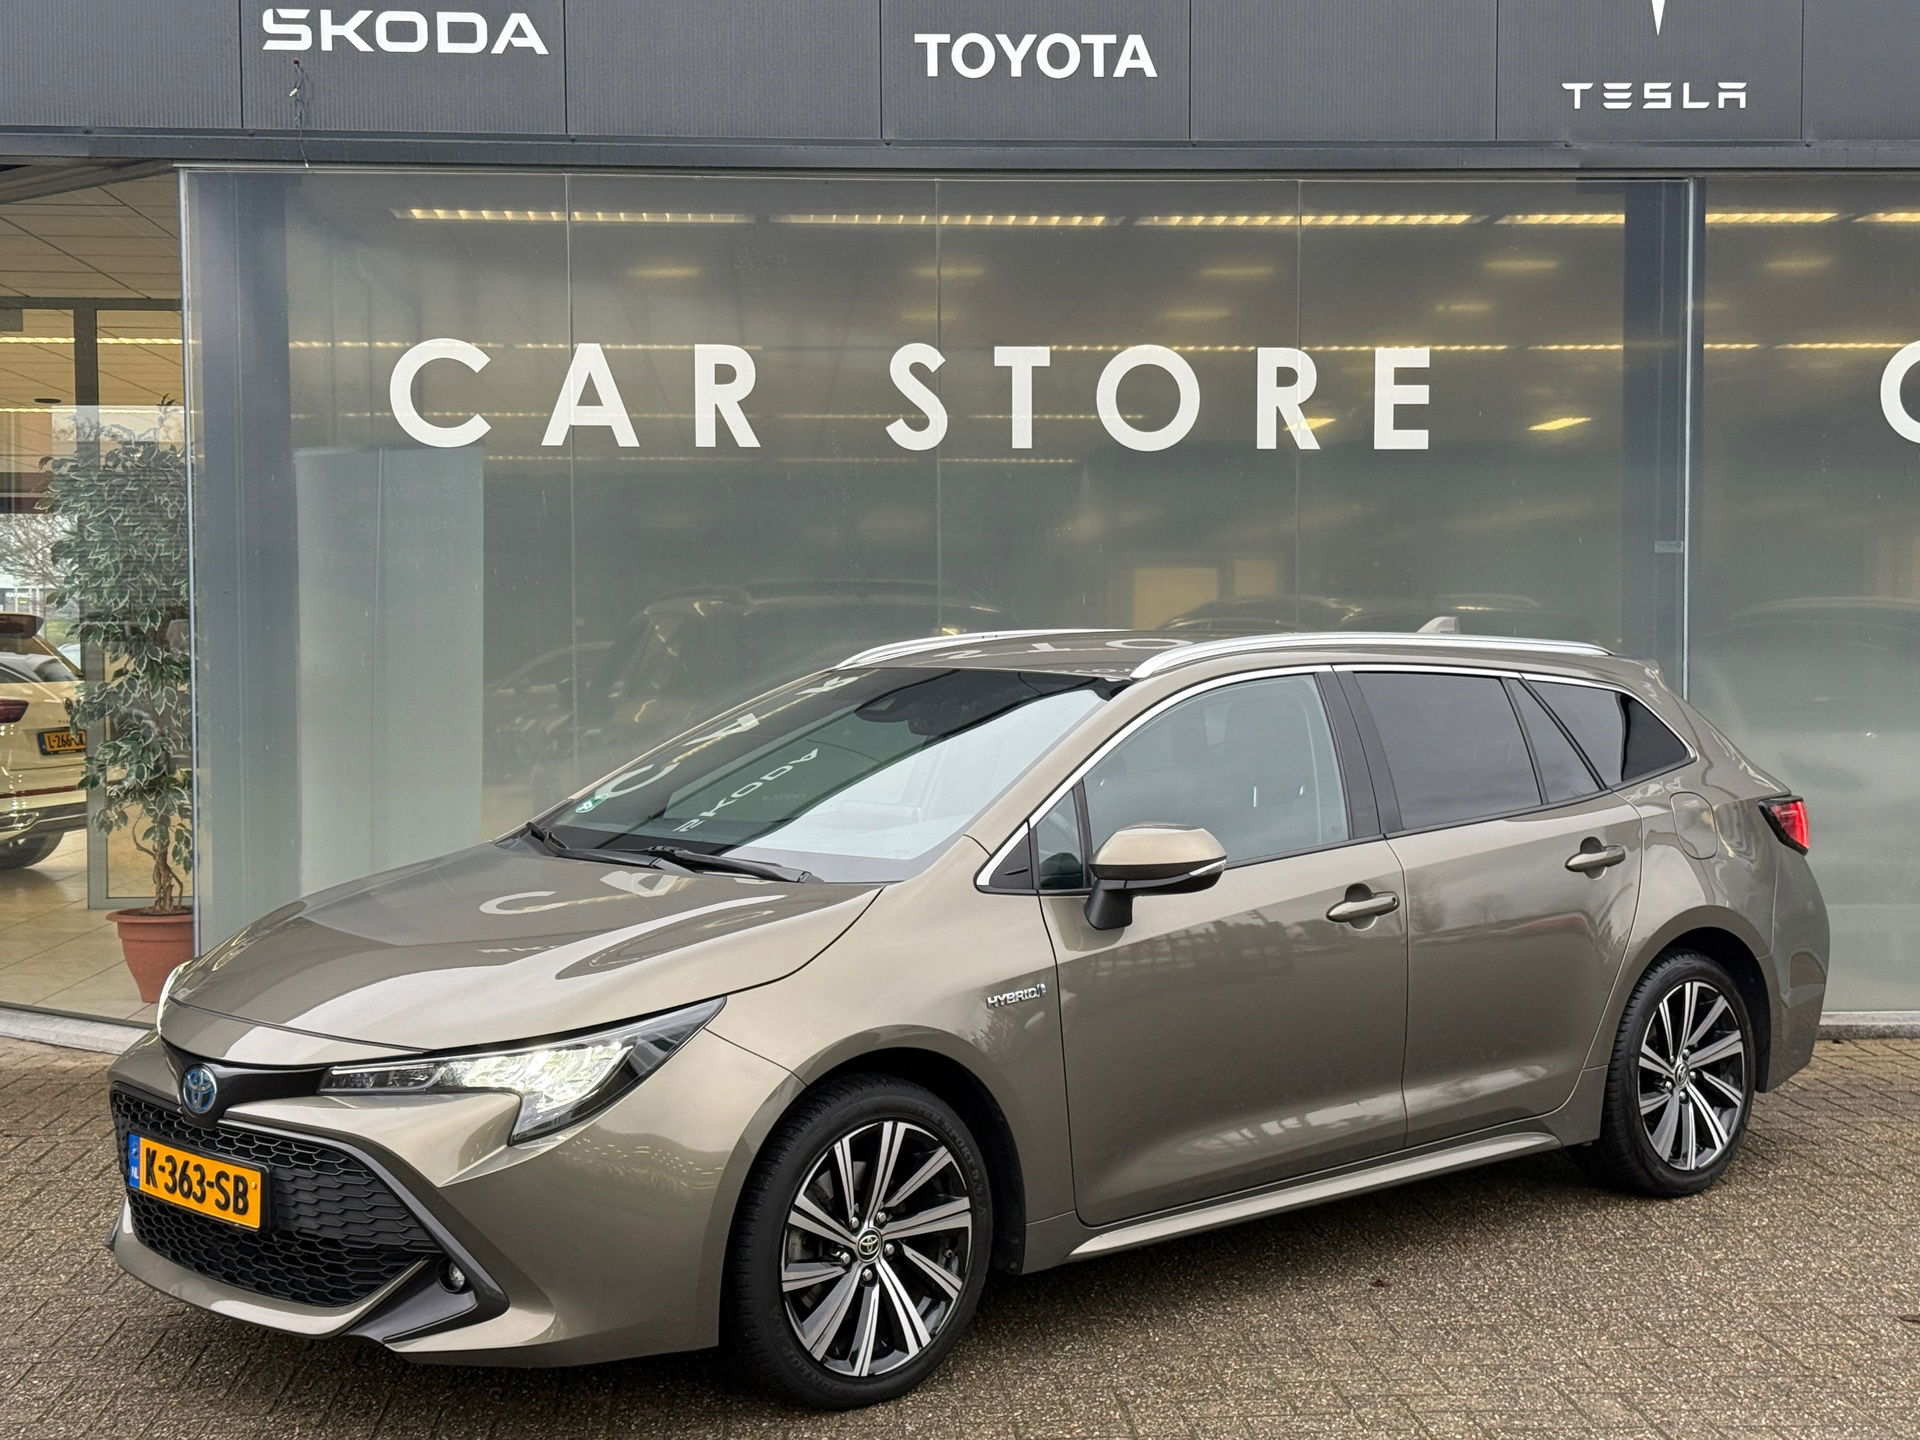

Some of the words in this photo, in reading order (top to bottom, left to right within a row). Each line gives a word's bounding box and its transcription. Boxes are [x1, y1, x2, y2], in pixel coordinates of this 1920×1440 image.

[914, 32, 1158, 79] TOYOTA
[1561, 82, 1747, 109] TESLA
[389, 337, 761, 449] CAR
[885, 342, 1431, 452] STORE
[986, 987, 1038, 1009] HYBRID
[131, 1165, 140, 1180] NL
[145, 1147, 250, 1216] K-363-SB
